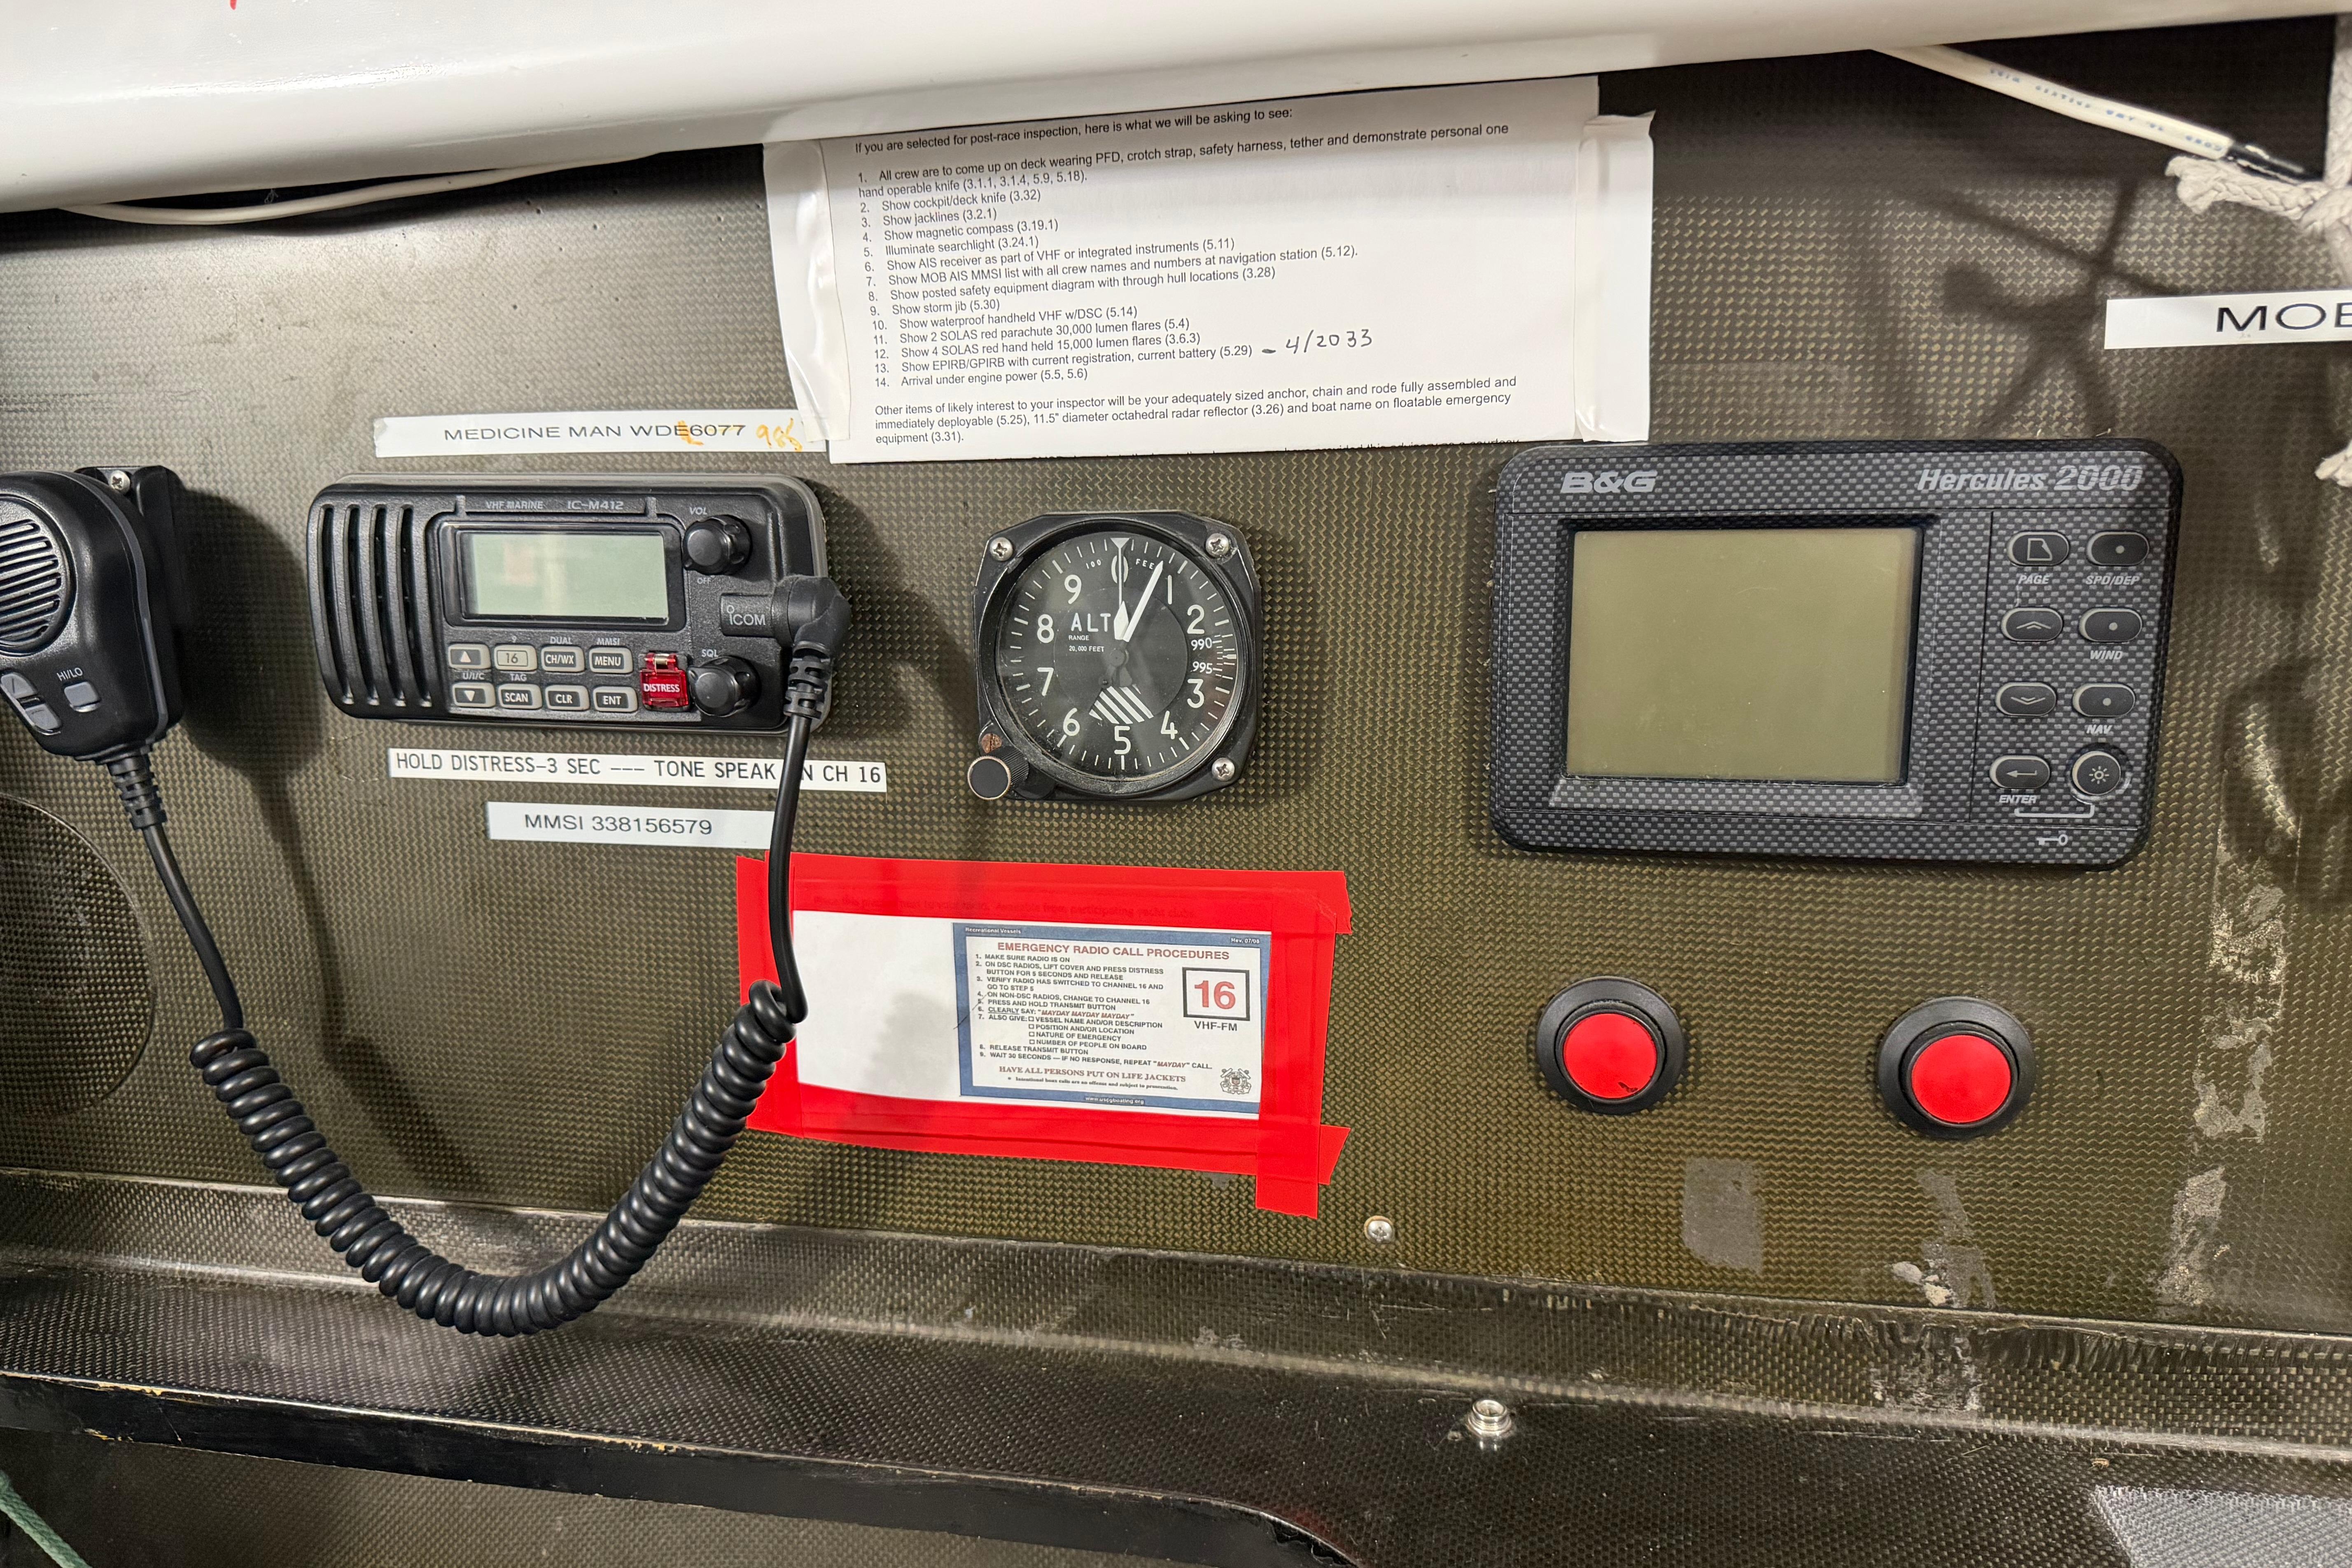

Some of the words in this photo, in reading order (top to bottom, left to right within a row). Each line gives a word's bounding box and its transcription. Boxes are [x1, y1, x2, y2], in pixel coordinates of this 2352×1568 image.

[855, 142, 862, 153] If
[864, 143, 883, 155] you
[887, 141, 903, 151] are
[906, 135, 950, 149] selected
[953, 134, 968, 145] for
[970, 132, 1020, 146] post-race
[1024, 125, 1081, 140] inspection,
[1085, 123, 1110, 134] here
[1113, 121, 1122, 132] is
[1125, 119, 1152, 131] what
[1155, 119, 1171, 128] we
[1174, 114, 1192, 126] will
[1196, 114, 1210, 125] be
[1213, 111, 1251, 124] asking
[1254, 110, 1265, 120] to
[1268, 109, 1292, 119] see:
[860, 202, 869, 213] 2.
[882, 200, 910, 211] Show
[913, 193, 978, 210] cockpit/deck
[980, 191, 1006, 204] knife
[1009, 188, 1041, 204] (3.32)
[861, 217, 870, 228] 3.
[883, 215, 912, 226] Show
[915, 211, 959, 226] jacklines
[962, 207, 997, 223] (3.2.1)
[870, 306, 880, 316] 9.
[892, 304, 921, 315] Show
[923, 303, 952, 313] storm
[955, 301, 967, 314] jib
[970, 298, 1000, 313] (5.30)
[874, 335, 887, 345] 11.
[900, 333, 928, 343] Show
[931, 331, 937, 342] 2
[940, 329, 978, 341] SOLAS
[981, 328, 997, 339] red
[1001, 326, 1052, 341] parachute
[1056, 323, 1092, 336] 30,000
[1095, 322, 1128, 333] lumen
[1132, 320, 1161, 331] flares
[1164, 317, 1189, 332] (5.4)
[1286, 329, 1374, 354] 4/2033
[875, 363, 889, 373] 13.
[902, 362, 929, 372] Show
[933, 357, 1005, 371] EPIRB/GPIRB
[1008, 356, 1029, 367] with
[1032, 355, 1069, 366] current
[1072, 352, 1134, 366] registration,
[1138, 349, 1176, 361] current
[1179, 348, 1216, 360] battery
[1220, 345, 1252, 359] (5.29)
[444, 427, 562, 441] MEDICINE
[569, 425, 621, 437] MAN
[631, 424, 746, 438] WDE6077
[875, 432, 929, 446] equipment
[931, 431, 964, 444] (3.31).
[1560, 471, 1658, 494] B&G
[1917, 469, 2047, 491] Hercules
[2053, 465, 2143, 491] 2000
[486, 501, 506, 509] VHF
[507, 501, 543, 509] MARINE
[567, 501, 623, 510] IC-M412
[689, 506, 707, 515] VOL
[1135, 558, 1155, 570] FEE
[2018, 574, 2050, 584] PAGE
[2085, 574, 2140, 585] SPD/DEP
[1064, 575, 1082, 604] 9
[1071, 613, 1111, 632] ALT
[1187, 605, 1204, 634] 2
[1037, 614, 1054, 643] 8
[597, 637, 620, 645] MMSI
[1191, 639, 1212, 650] 990
[505, 653, 518, 664] 16
[545, 653, 574, 665] CH/WX
[702, 649, 718, 657] SQL
[2089, 650, 2122, 660] WIND
[595, 655, 621, 667] MENU
[1191, 661, 1213, 673] 995
[57, 667, 84, 681] HI/LO
[510, 672, 527, 681] TAG
[1037, 667, 1054, 696] 7
[643, 682, 680, 694] DISTRESS
[1187, 679, 1204, 708] 3
[505, 691, 529, 702] SCAN
[556, 693, 572, 705] CLR
[603, 694, 621, 706] ENT
[1063, 708, 1080, 736] 6
[1161, 711, 1178, 740] 4
[2086, 724, 2112, 734] NAV
[1114, 726, 1131, 754] 5
[397, 754, 443, 770] HOLD
[452, 756, 558, 773] DISTRESS-3
[568, 758, 601, 775] SEC
[655, 759, 705, 777] TONE
[715, 763, 776, 780] SPEAK
[822, 766, 848, 782] CH
[859, 767, 881, 784] 16
[1998, 794, 2037, 804] ENTER
[525, 814, 584, 831] MMSI
[591, 816, 713, 835] 338156579
[998, 942, 1070, 953] EMERGENCY
[1073, 945, 1109, 954] RADIO
[1113, 947, 1144, 956] CALL
[1147, 948, 1230, 960] PROCEDURES
[1194, 980, 1236, 1009] 16
[1194, 1021, 1237, 1031] VHF-FM
[1044, 1068, 1085, 1076] PERSONS
[1144, 1073, 1186, 1082] JACKETS
